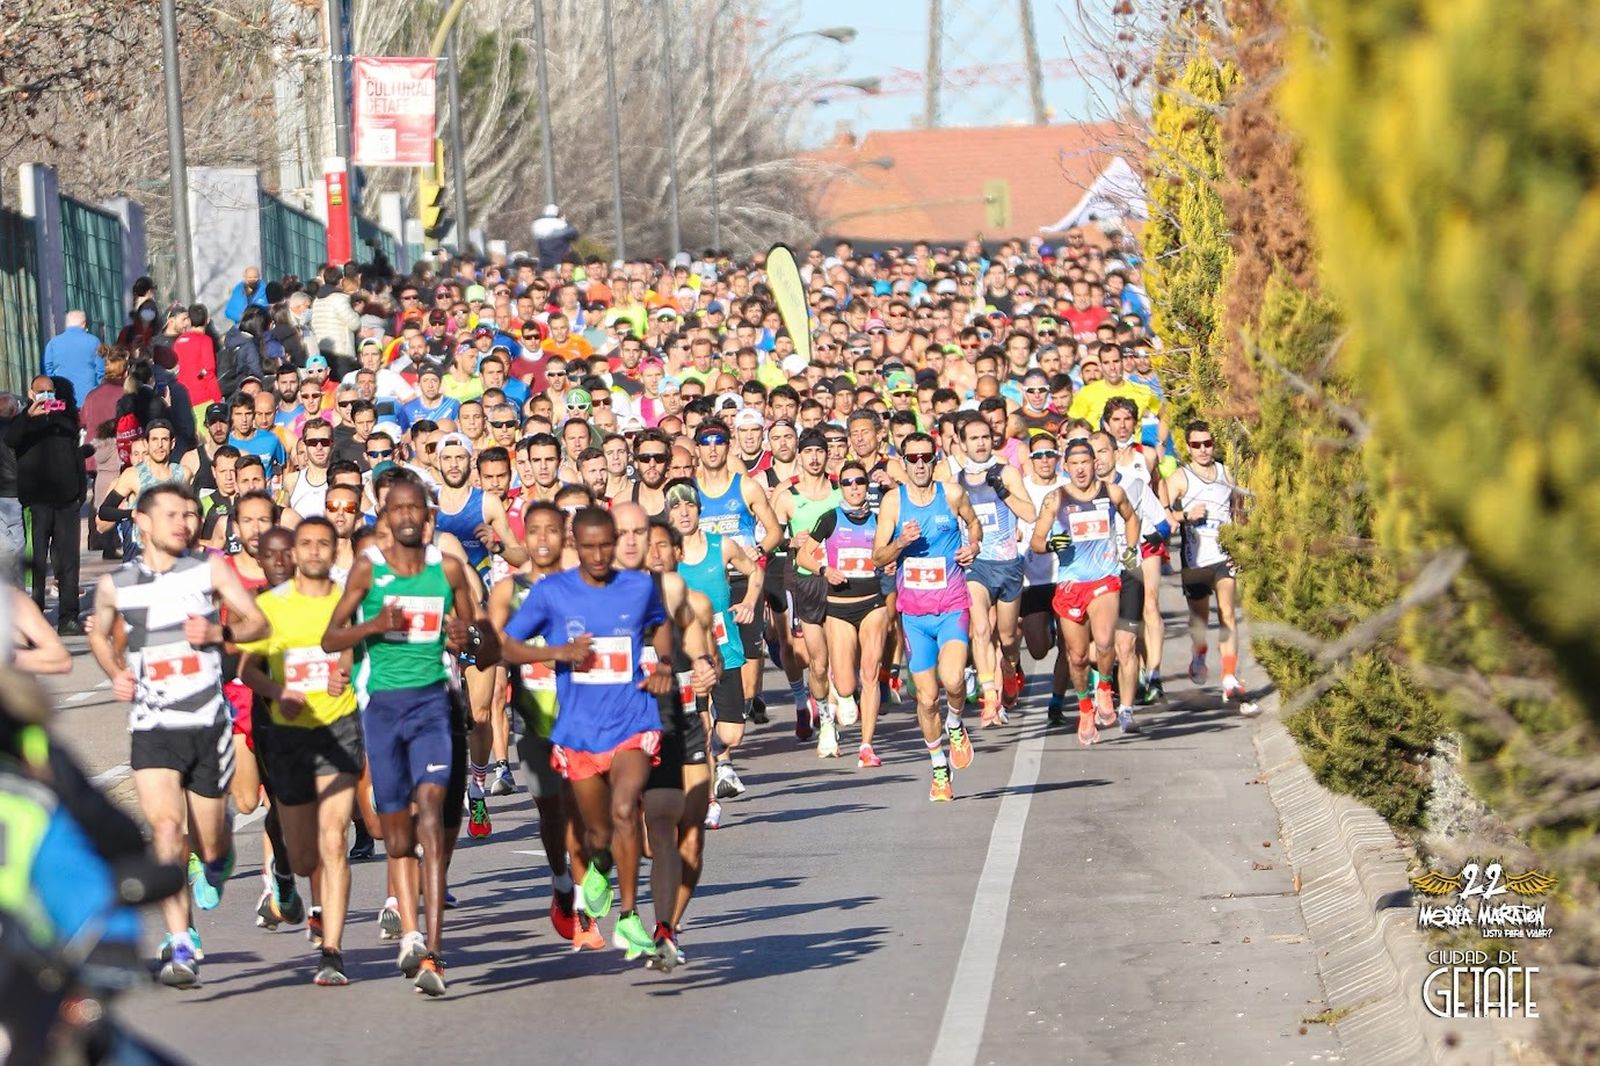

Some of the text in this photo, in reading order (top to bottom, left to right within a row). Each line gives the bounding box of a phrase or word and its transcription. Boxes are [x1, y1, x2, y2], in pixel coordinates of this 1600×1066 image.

[366, 80, 431, 97] CULTURAL
[411, 614, 424, 629] 6
[307, 662, 330, 677] 22
